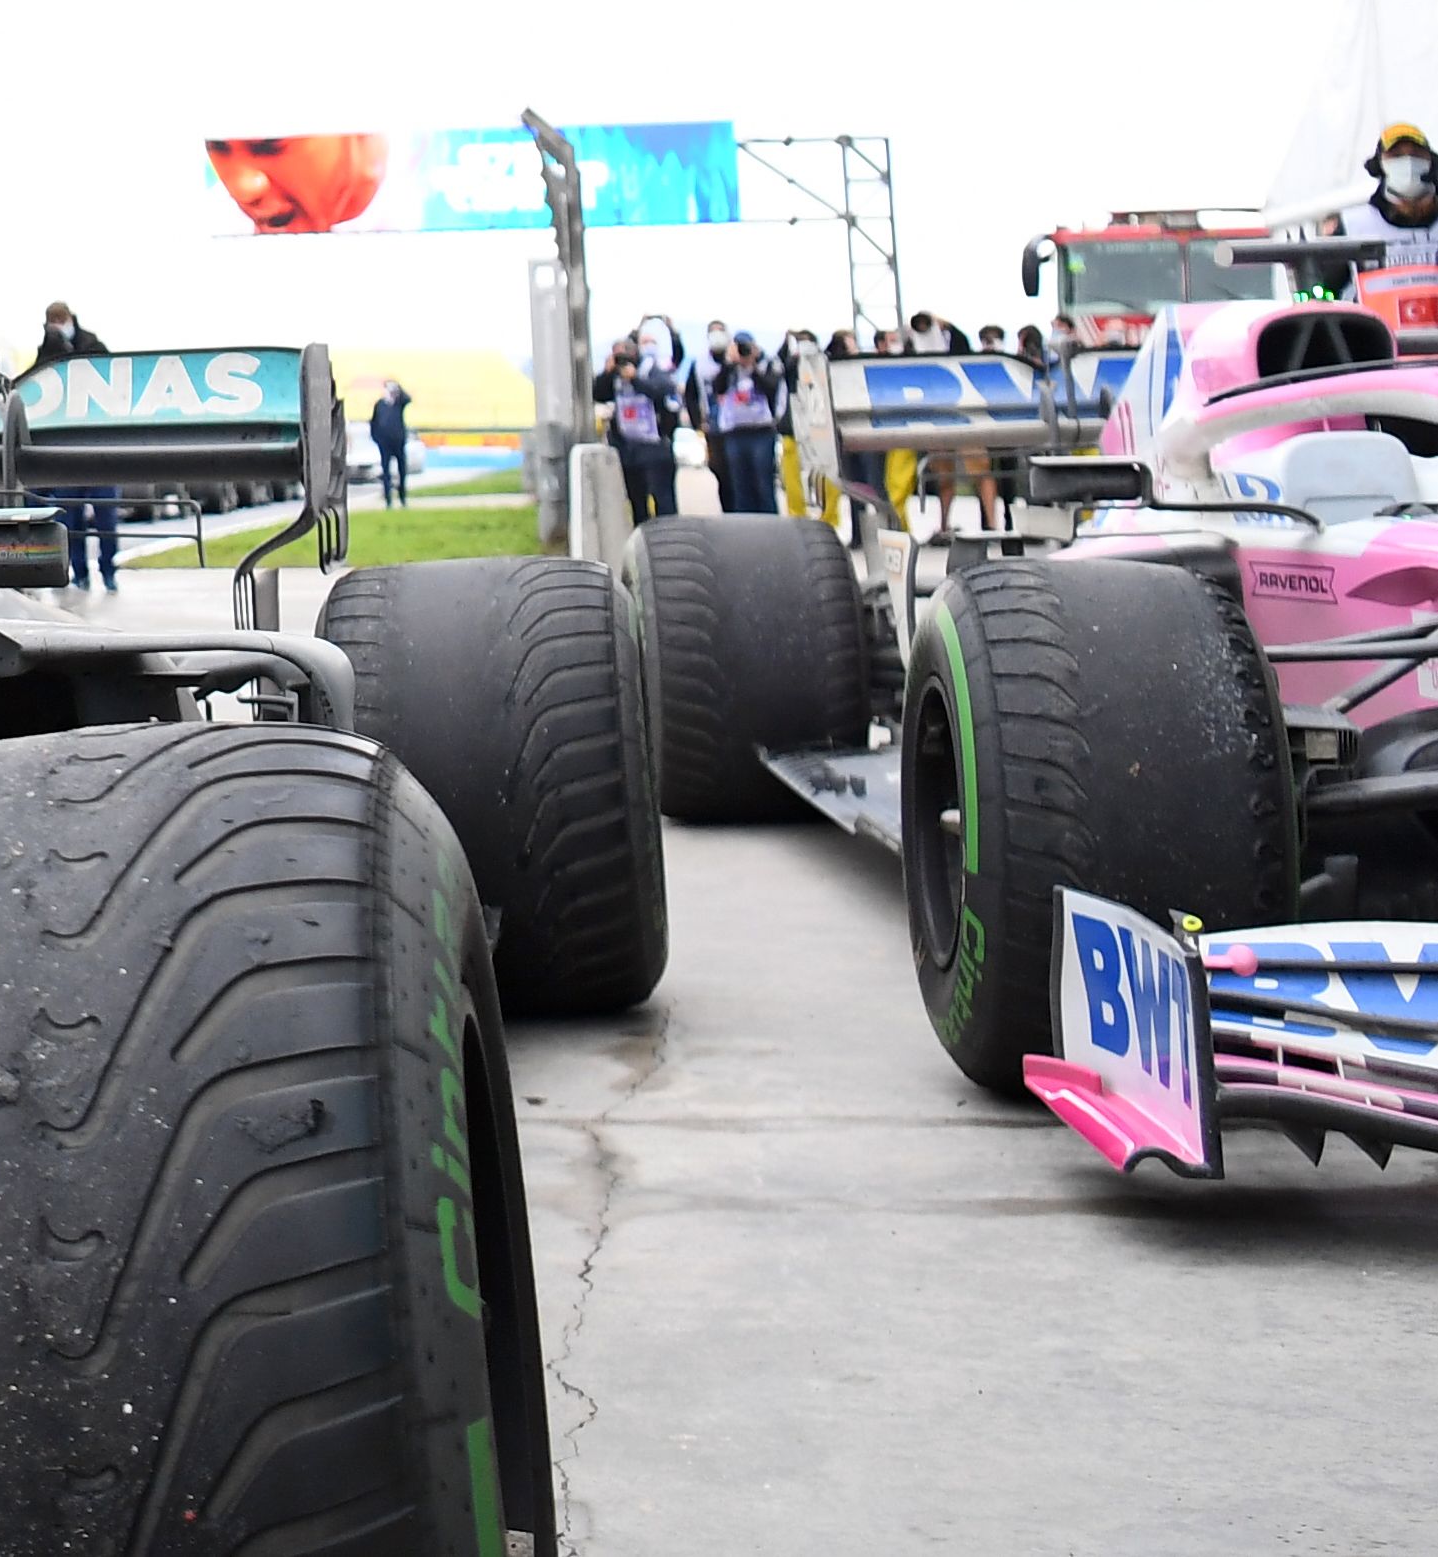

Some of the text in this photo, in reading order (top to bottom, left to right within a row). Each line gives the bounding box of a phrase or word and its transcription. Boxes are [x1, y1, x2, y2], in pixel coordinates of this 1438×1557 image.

[864, 357, 1137, 429] BW
[1258, 571, 1329, 594] RAVENOL
[1071, 909, 1193, 1110] BWT
[1205, 941, 1438, 1056] BW
